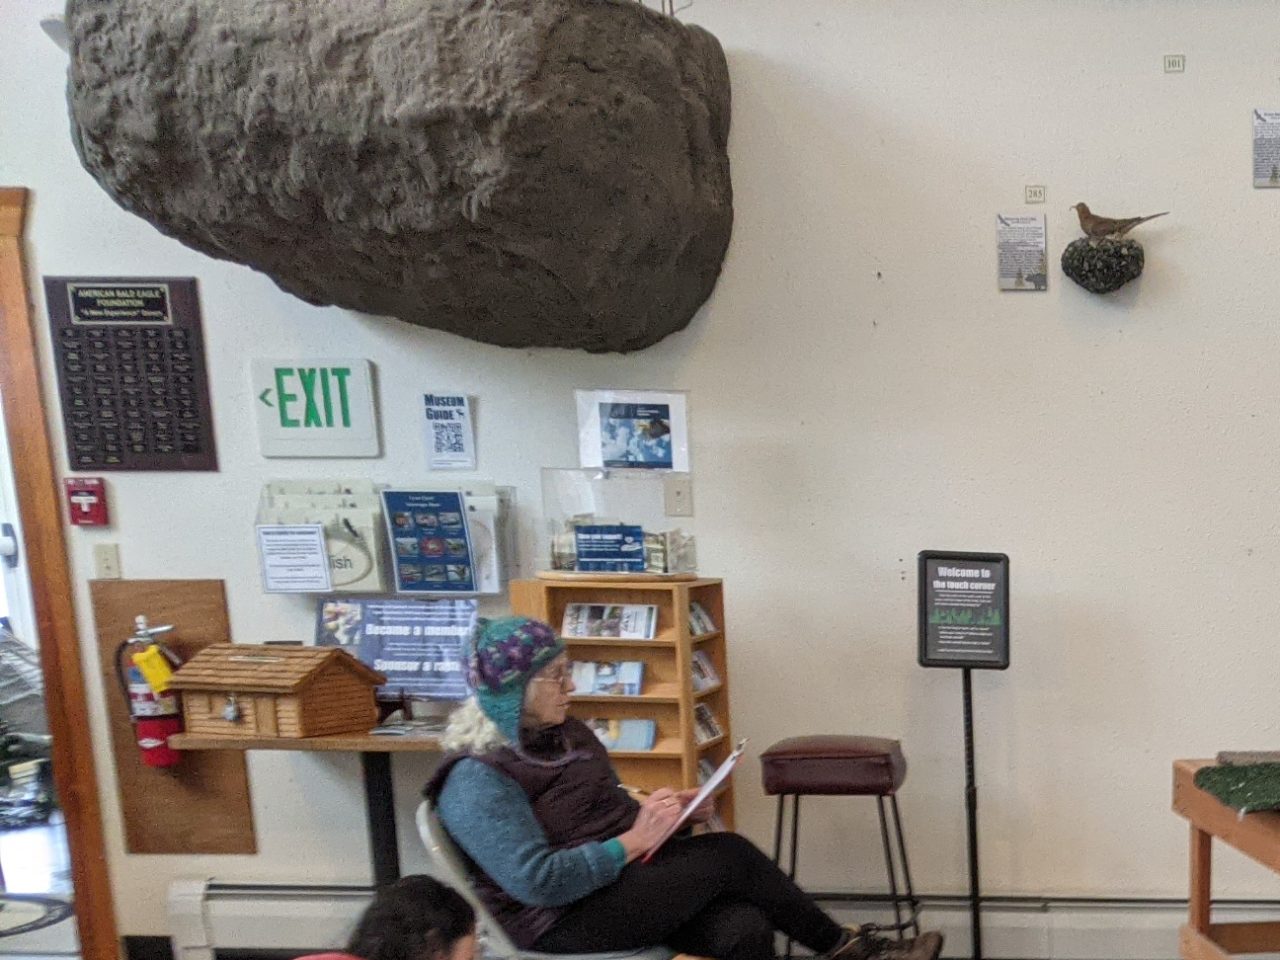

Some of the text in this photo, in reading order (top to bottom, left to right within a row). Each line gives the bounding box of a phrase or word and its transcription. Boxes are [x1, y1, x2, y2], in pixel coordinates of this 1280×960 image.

[78, 289, 161, 298] AMERICAN BALD EAGLE
[96, 298, 145, 307] FOUNDATION
[274, 367, 351, 428] EXIT
[937, 566, 991, 578] Welcome to
[933, 580, 996, 590] the touch corner
[365, 624, 411, 636] Become
[413, 626, 423, 636] a
[374, 659, 420, 672] Sponsor
[422, 661, 432, 671] a
